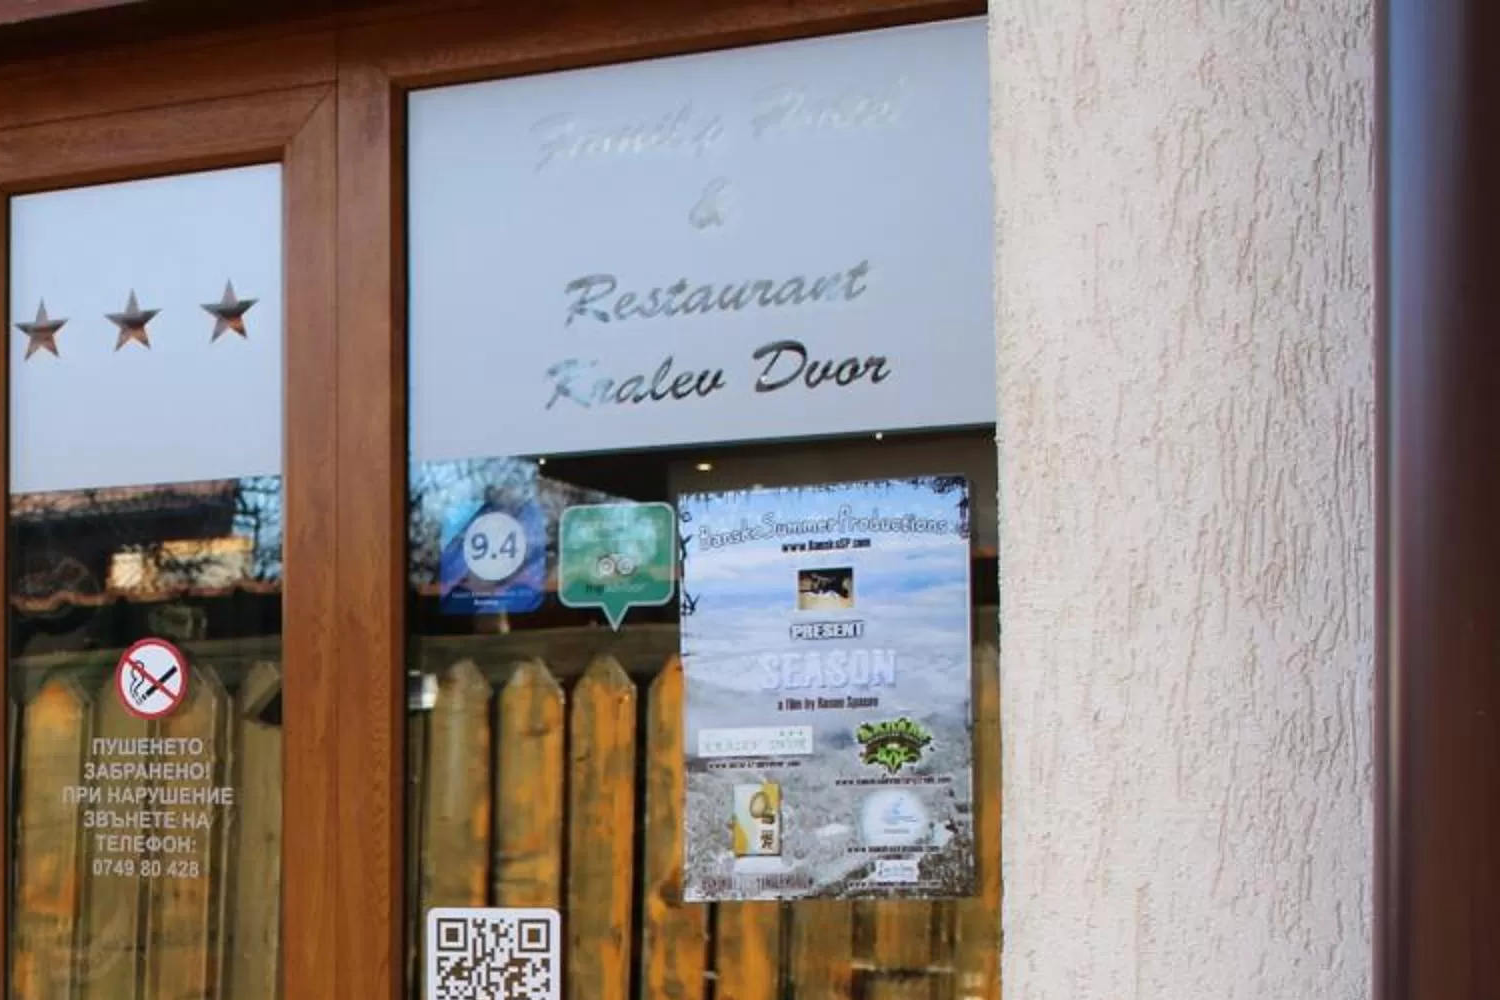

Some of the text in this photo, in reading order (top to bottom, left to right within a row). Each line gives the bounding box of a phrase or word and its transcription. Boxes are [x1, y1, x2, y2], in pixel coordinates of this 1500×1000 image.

[564, 260, 869, 327] Restaurant
[752, 340, 892, 393] Dvor
[470, 531, 518, 561] 9.4
[791, 621, 864, 640] PRESENT
[758, 649, 897, 690] SEASON
[92, 737, 203, 756] ПУШЕНЕТО
[84, 762, 211, 781] ЗАБРАНЕНО!
[62, 786, 234, 805] ПРИ НАРУШЕНИЕ
[84, 810, 210, 829] ЗВЪНЕТЕ НА
[95, 835, 197, 853] ТЕЛЕФОН:
[93, 859, 199, 877] 0749 80 428
